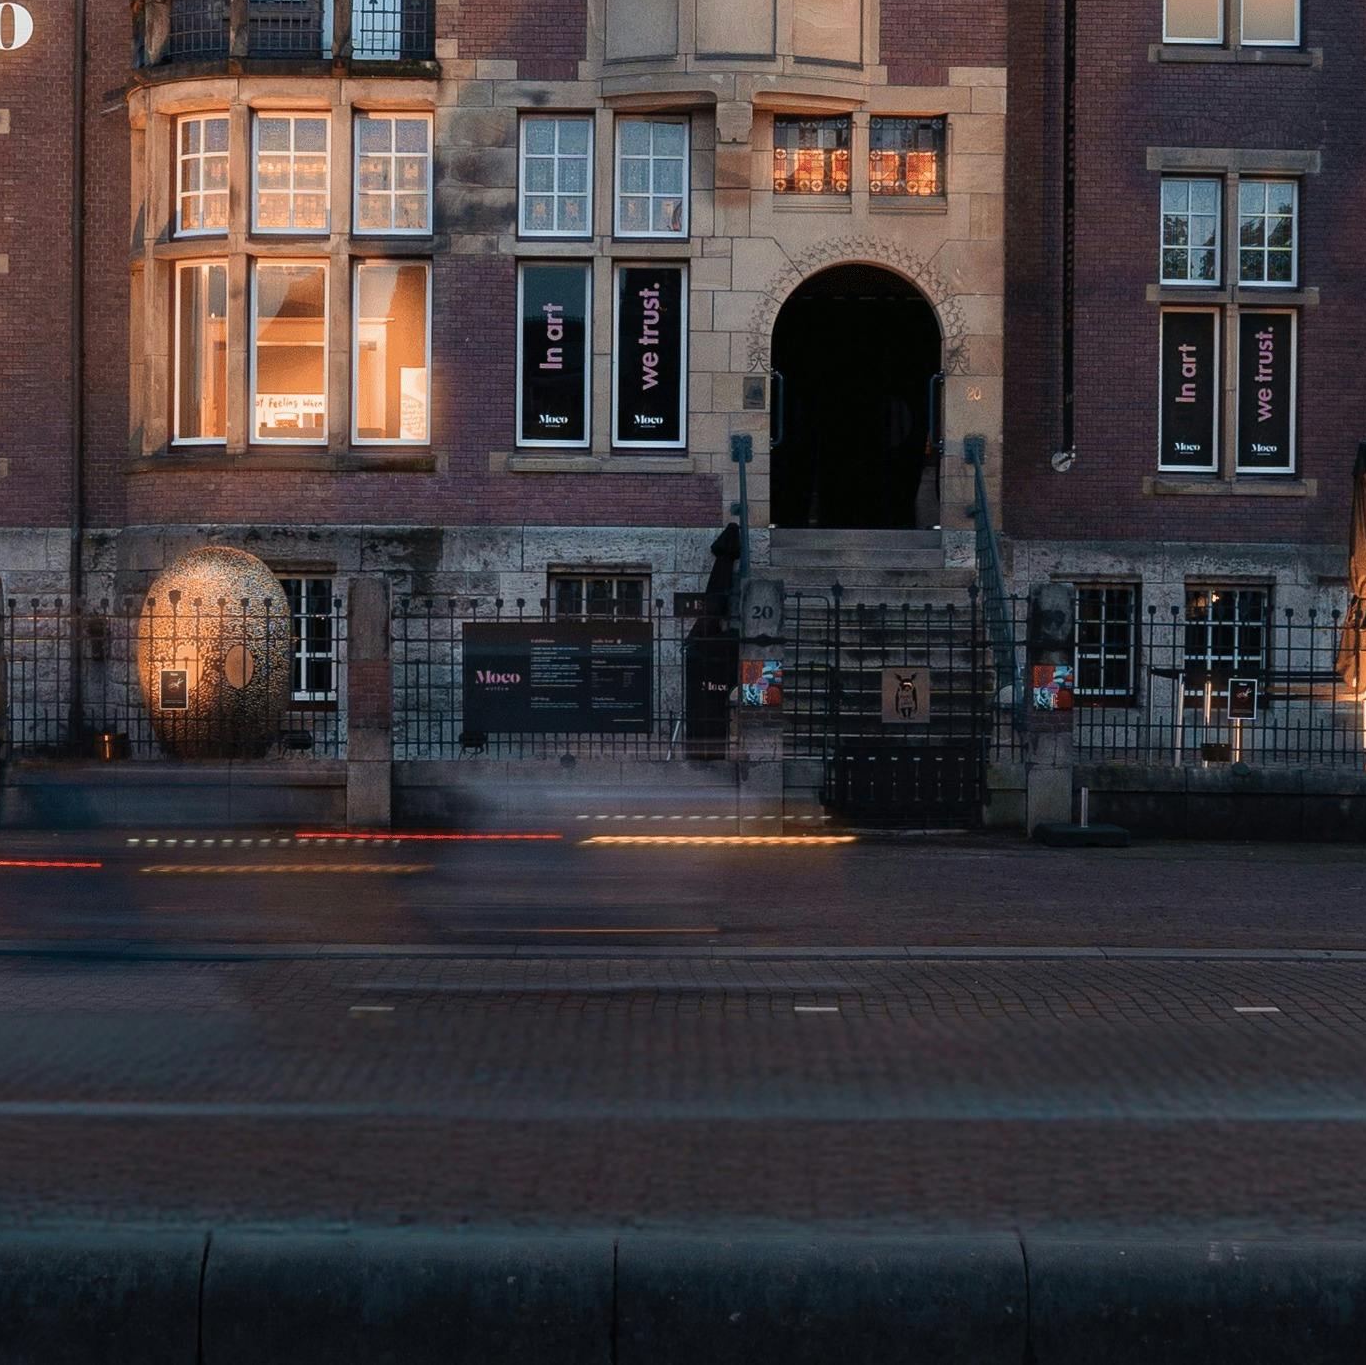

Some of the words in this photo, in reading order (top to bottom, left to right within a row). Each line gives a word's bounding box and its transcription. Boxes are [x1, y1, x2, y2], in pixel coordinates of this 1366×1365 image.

[542, 303, 563, 341] art
[638, 282, 660, 345] trust.
[539, 348, 563, 370] In
[1178, 343, 1197, 378] art
[1254, 326, 1274, 382] trust.
[642, 352, 659, 391] we
[966, 386, 982, 401] 20
[1175, 383, 1197, 403] In
[1257, 389, 1273, 423] we
[539, 414, 568, 424] Moco
[634, 414, 663, 424] Moco
[1174, 442, 1200, 451] Moco
[1251, 443, 1277, 452] Moco
[751, 605, 773, 619] 20
[475, 669, 521, 684] Moco
